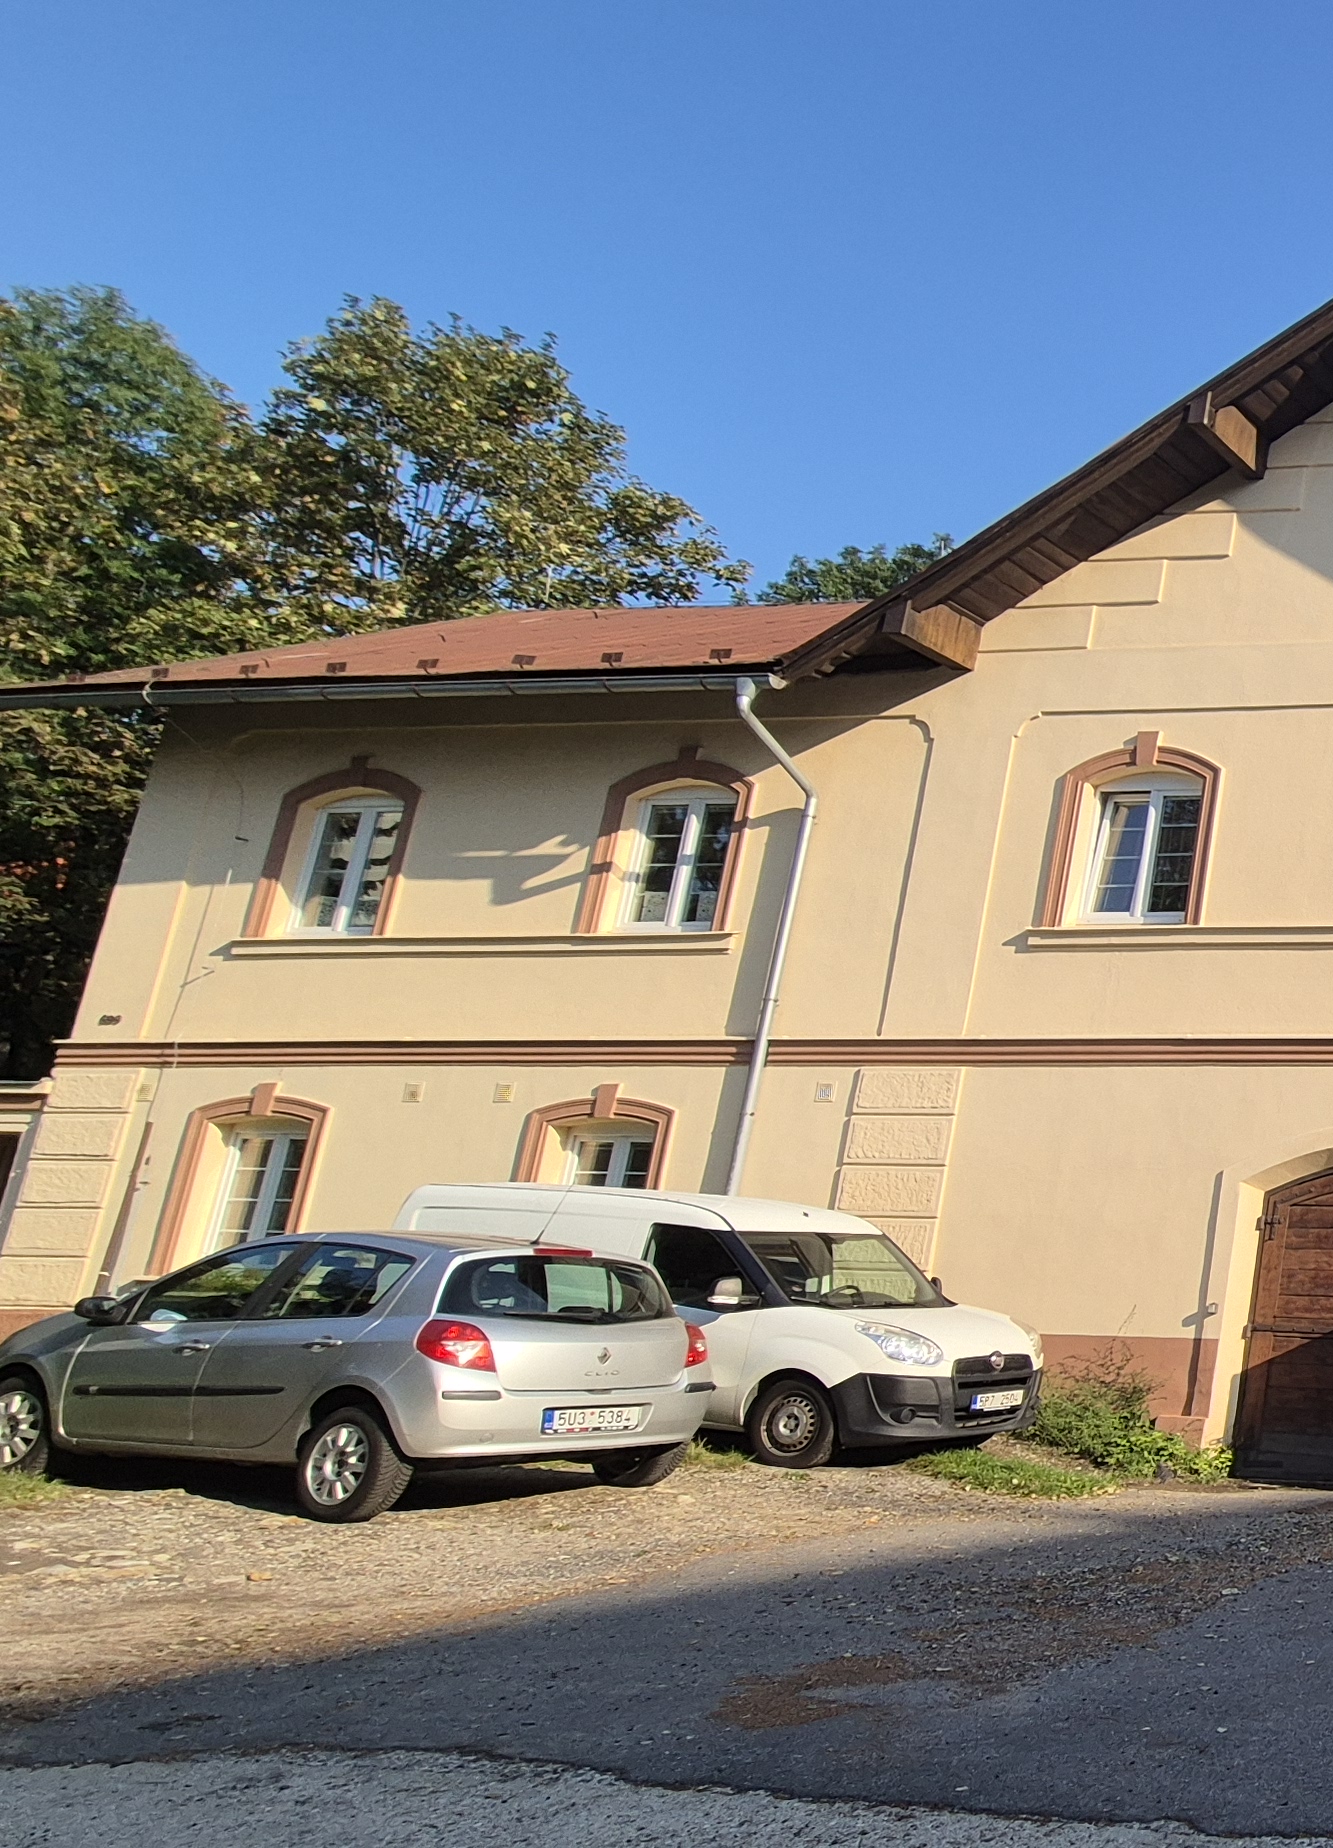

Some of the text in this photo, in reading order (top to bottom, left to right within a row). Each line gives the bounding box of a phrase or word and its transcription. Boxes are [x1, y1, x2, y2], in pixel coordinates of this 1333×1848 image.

[584, 1369, 620, 1377] CLIO
[557, 1409, 632, 1427] 5U3 5384
